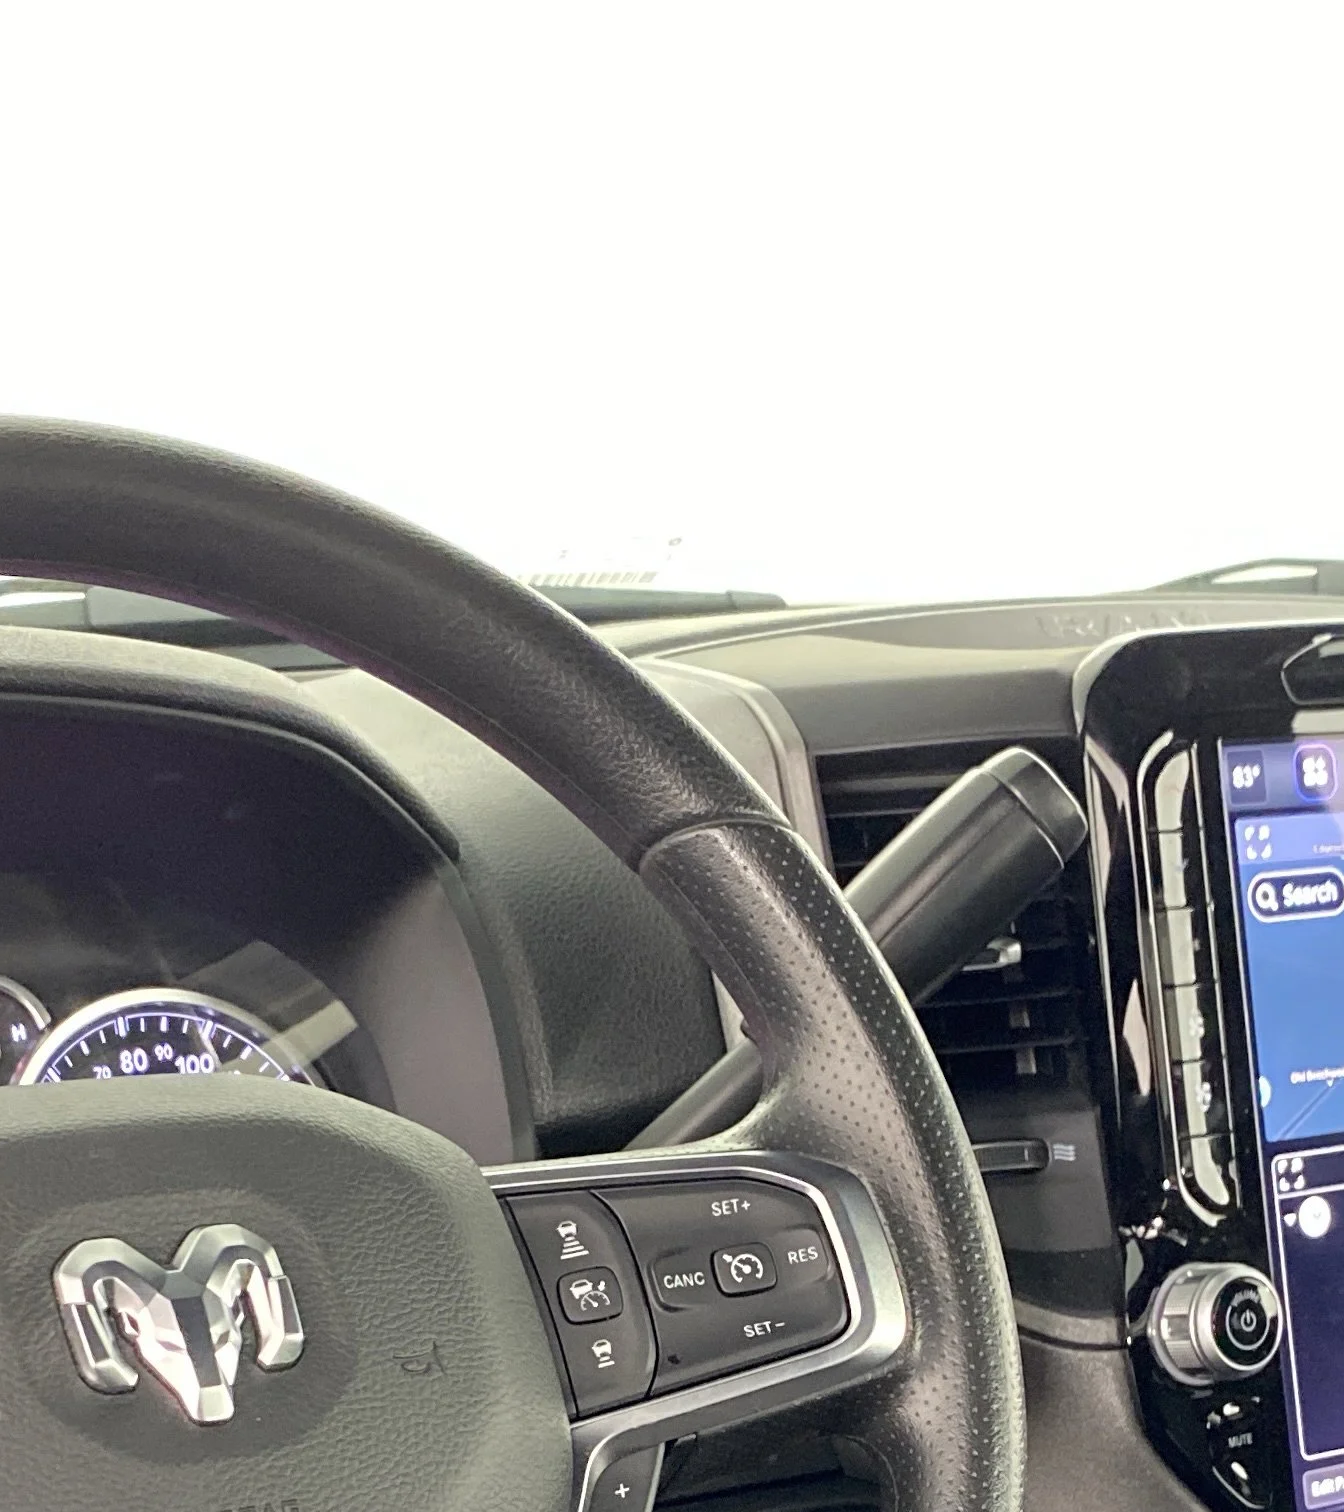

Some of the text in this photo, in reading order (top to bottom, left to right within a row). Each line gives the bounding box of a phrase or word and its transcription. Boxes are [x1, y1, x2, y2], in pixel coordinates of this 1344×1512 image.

[1282, 879, 1339, 907] Search
[119, 1047, 149, 1074] 80
[154, 1042, 173, 1061] 90
[174, 1053, 214, 1075] 100
[787, 1246, 819, 1265] RES
[663, 1271, 706, 1289] CANC
[1228, 1432, 1254, 1448] MUTE
